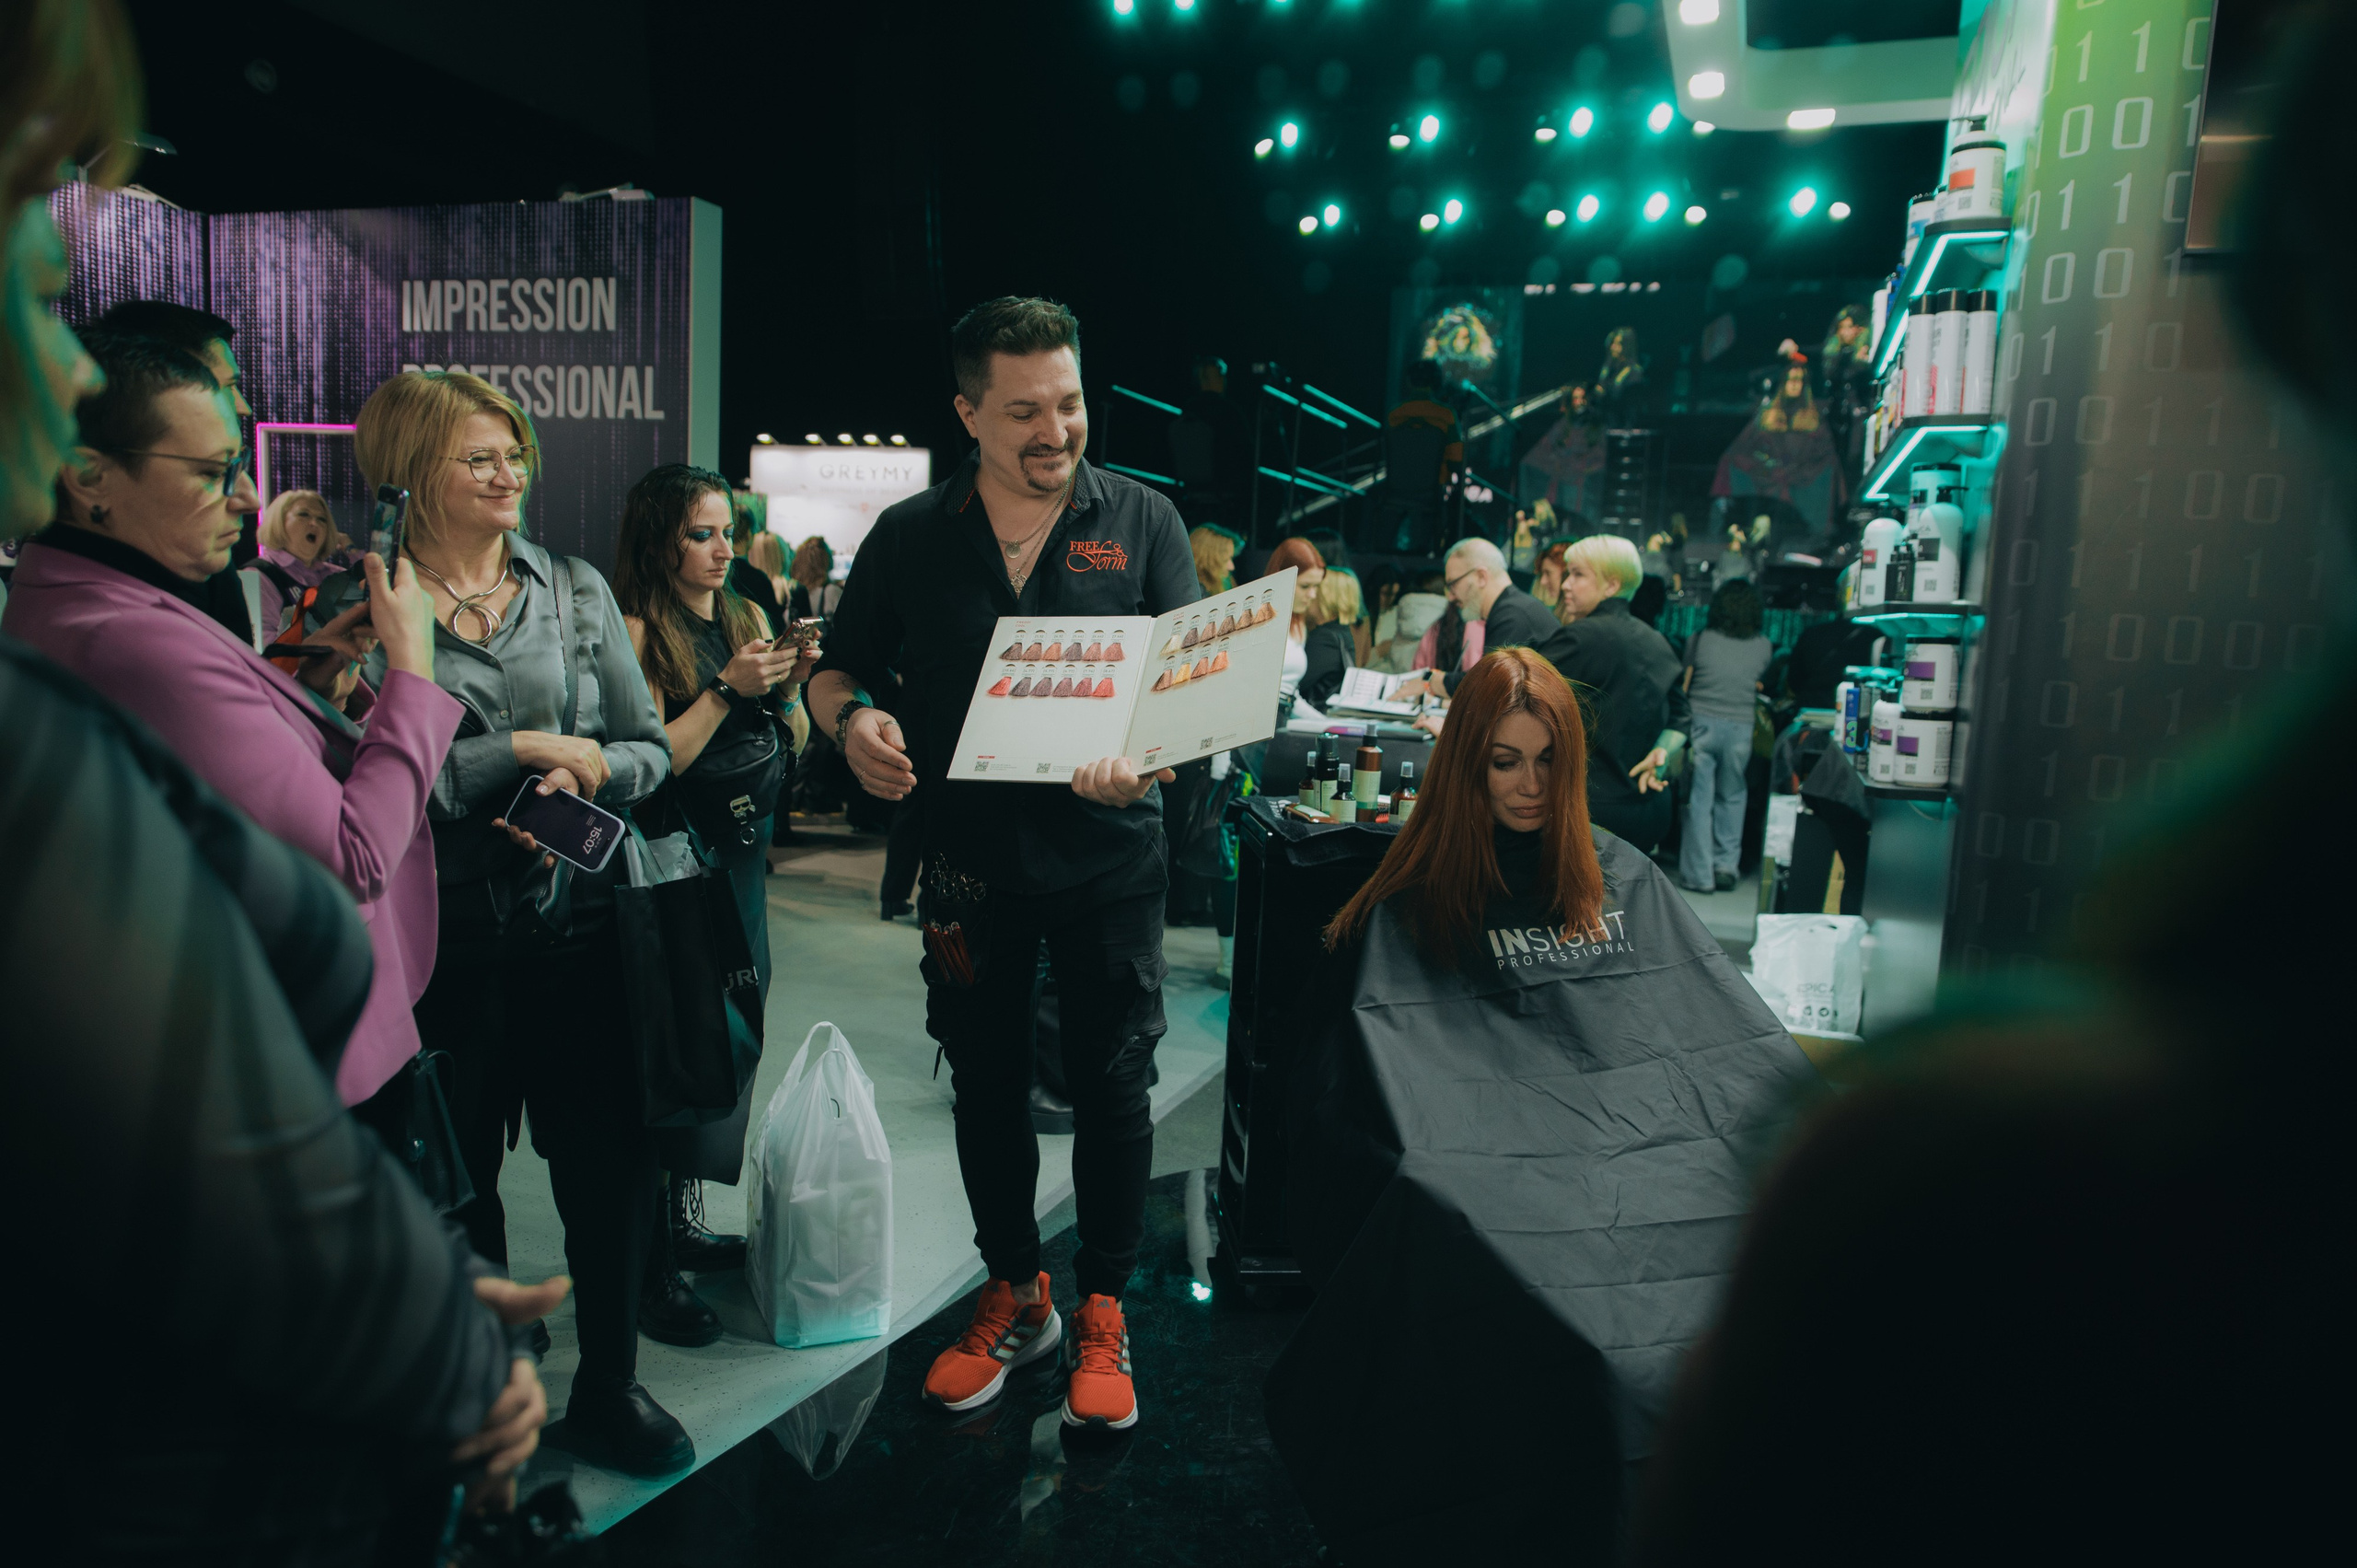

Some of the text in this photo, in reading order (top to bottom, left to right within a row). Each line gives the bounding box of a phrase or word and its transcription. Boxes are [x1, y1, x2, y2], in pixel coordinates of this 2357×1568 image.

[402, 277, 617, 332] IMPRESSION
[402, 364, 665, 420] ESSIONAL
[819, 463, 914, 482] GREYMY
[1069, 540, 1099, 552] FREE
[583, 827, 602, 854] 15:07
[1487, 911, 1625, 958] INSIGHT
[1497, 941, 1634, 970] PROFESSIONAL
